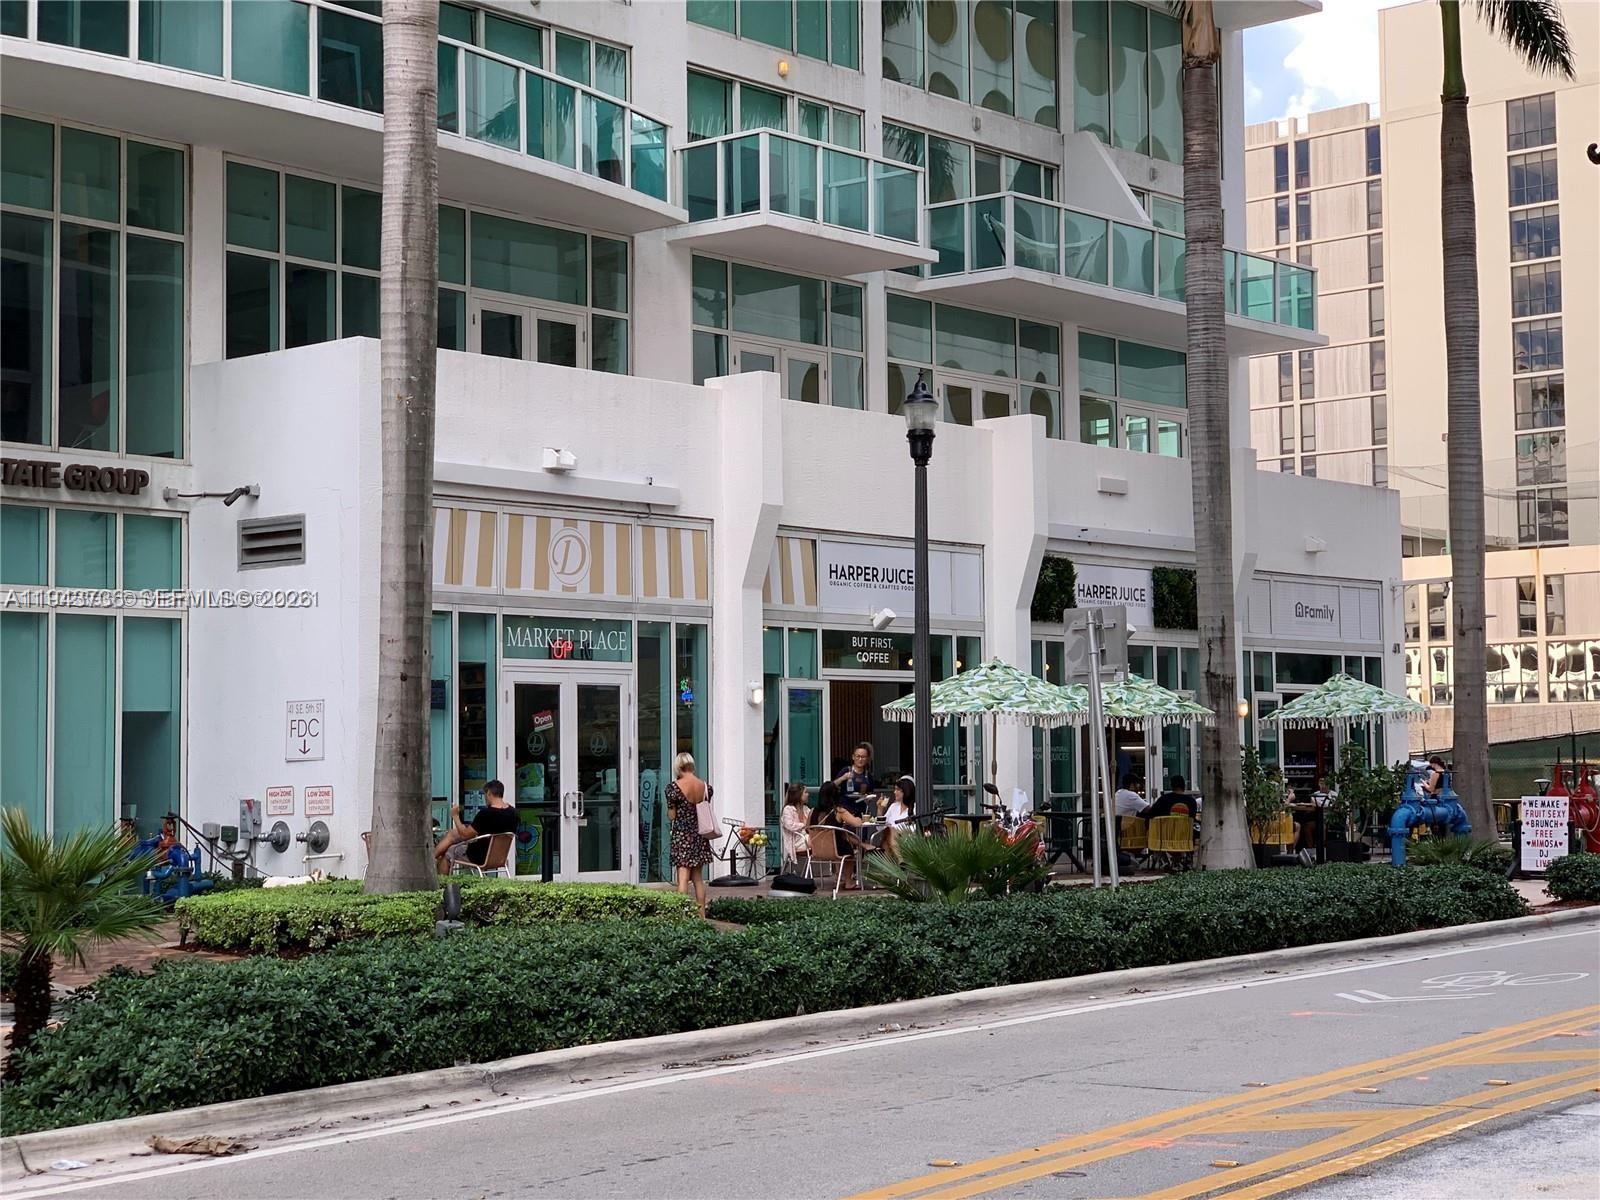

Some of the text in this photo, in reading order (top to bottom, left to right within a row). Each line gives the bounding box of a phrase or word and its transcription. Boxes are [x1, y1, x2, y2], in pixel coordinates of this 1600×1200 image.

[64, 464, 149, 495] GROUP
[1304, 604, 1335, 622] Family
[507, 626, 628, 651] MARKET PLACE
[852, 636, 894, 650] BUT FIRST,
[856, 651, 890, 664] COFFEE
[533, 714, 552, 725] Open
[290, 718, 320, 738] FDC
[932, 745, 951, 757] ACAI
[641, 780, 651, 812] ZICO
[1528, 800, 1560, 808] WE MAKE
[1525, 809, 1566, 818] FRUIT SEXY
[1530, 820, 1559, 828] BRUNCH
[1535, 829, 1553, 838] FREE
[1531, 839, 1559, 848] MIMOSA
[1539, 849, 1549, 858] DJ
